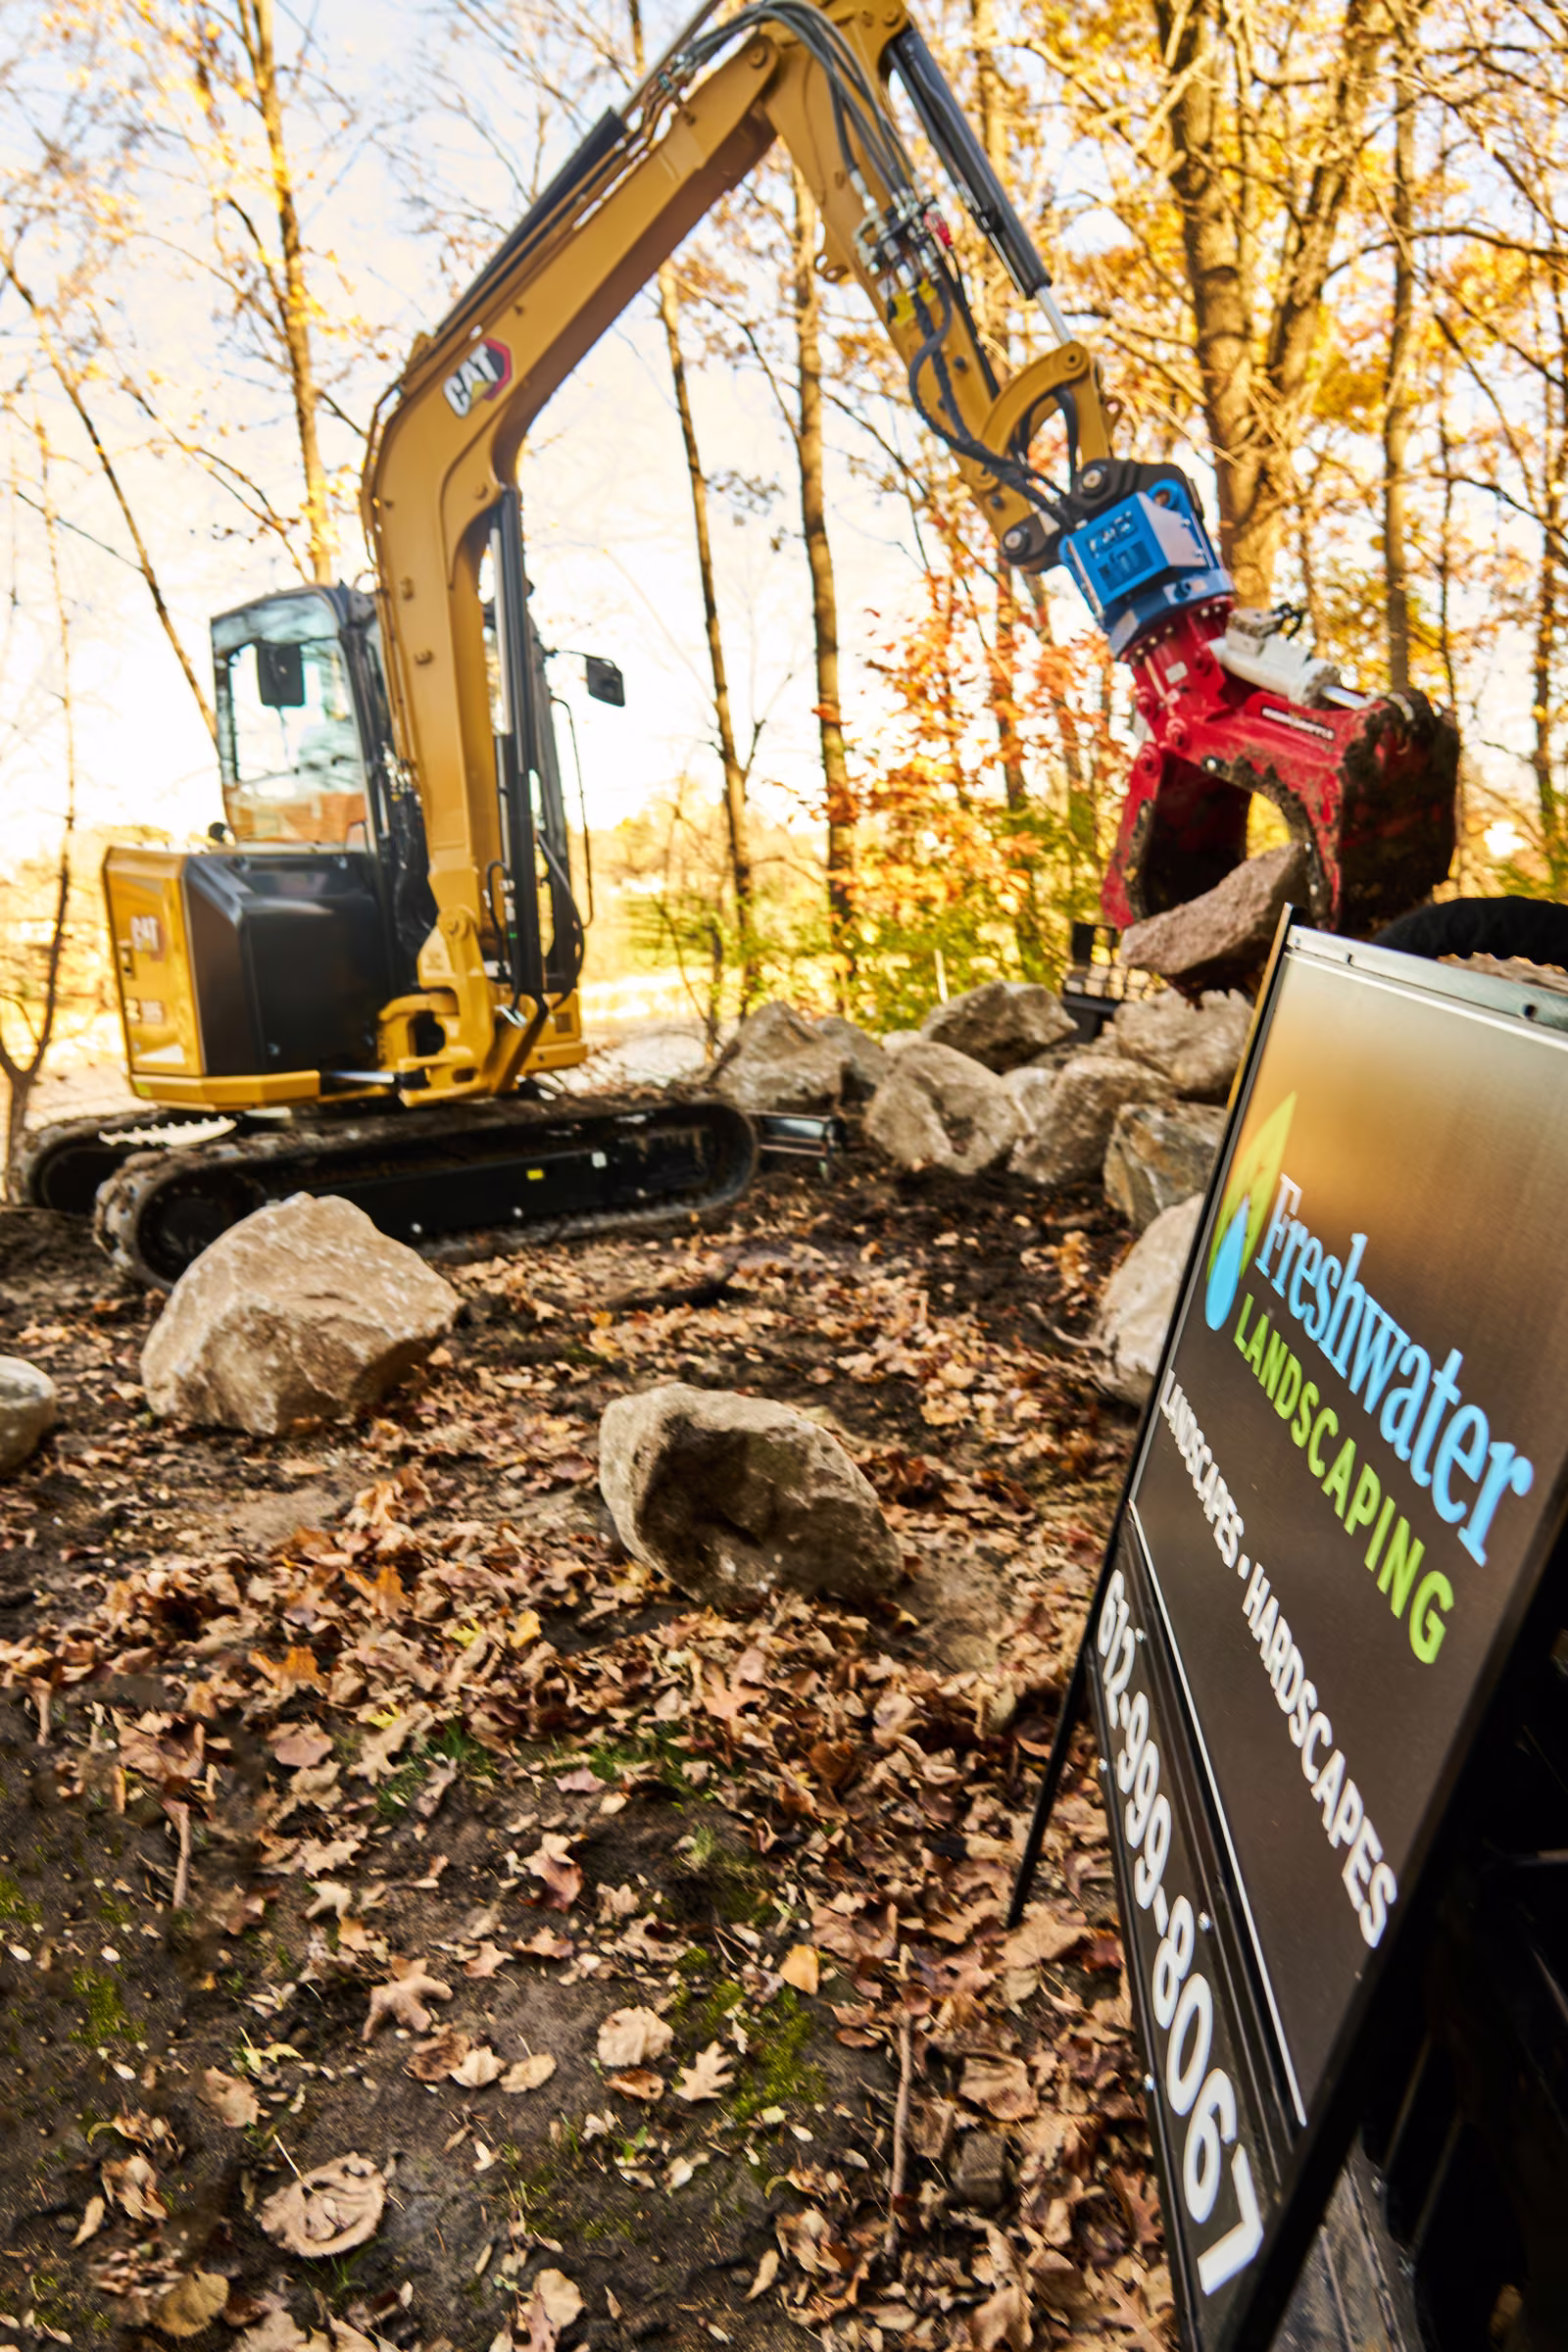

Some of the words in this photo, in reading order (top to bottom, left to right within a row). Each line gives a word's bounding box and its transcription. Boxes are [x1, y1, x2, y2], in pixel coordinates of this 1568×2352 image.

[443, 343, 499, 416] CAT
[1233, 1292, 1455, 1665] LANDSCAPING
[1254, 1172, 1535, 1568] Freshwater
[1159, 1368, 1246, 1568] LANDSCAPES
[1242, 1561, 1398, 1949] HARDSCAPES
[1097, 1568, 1265, 2296] 612-999-8067
